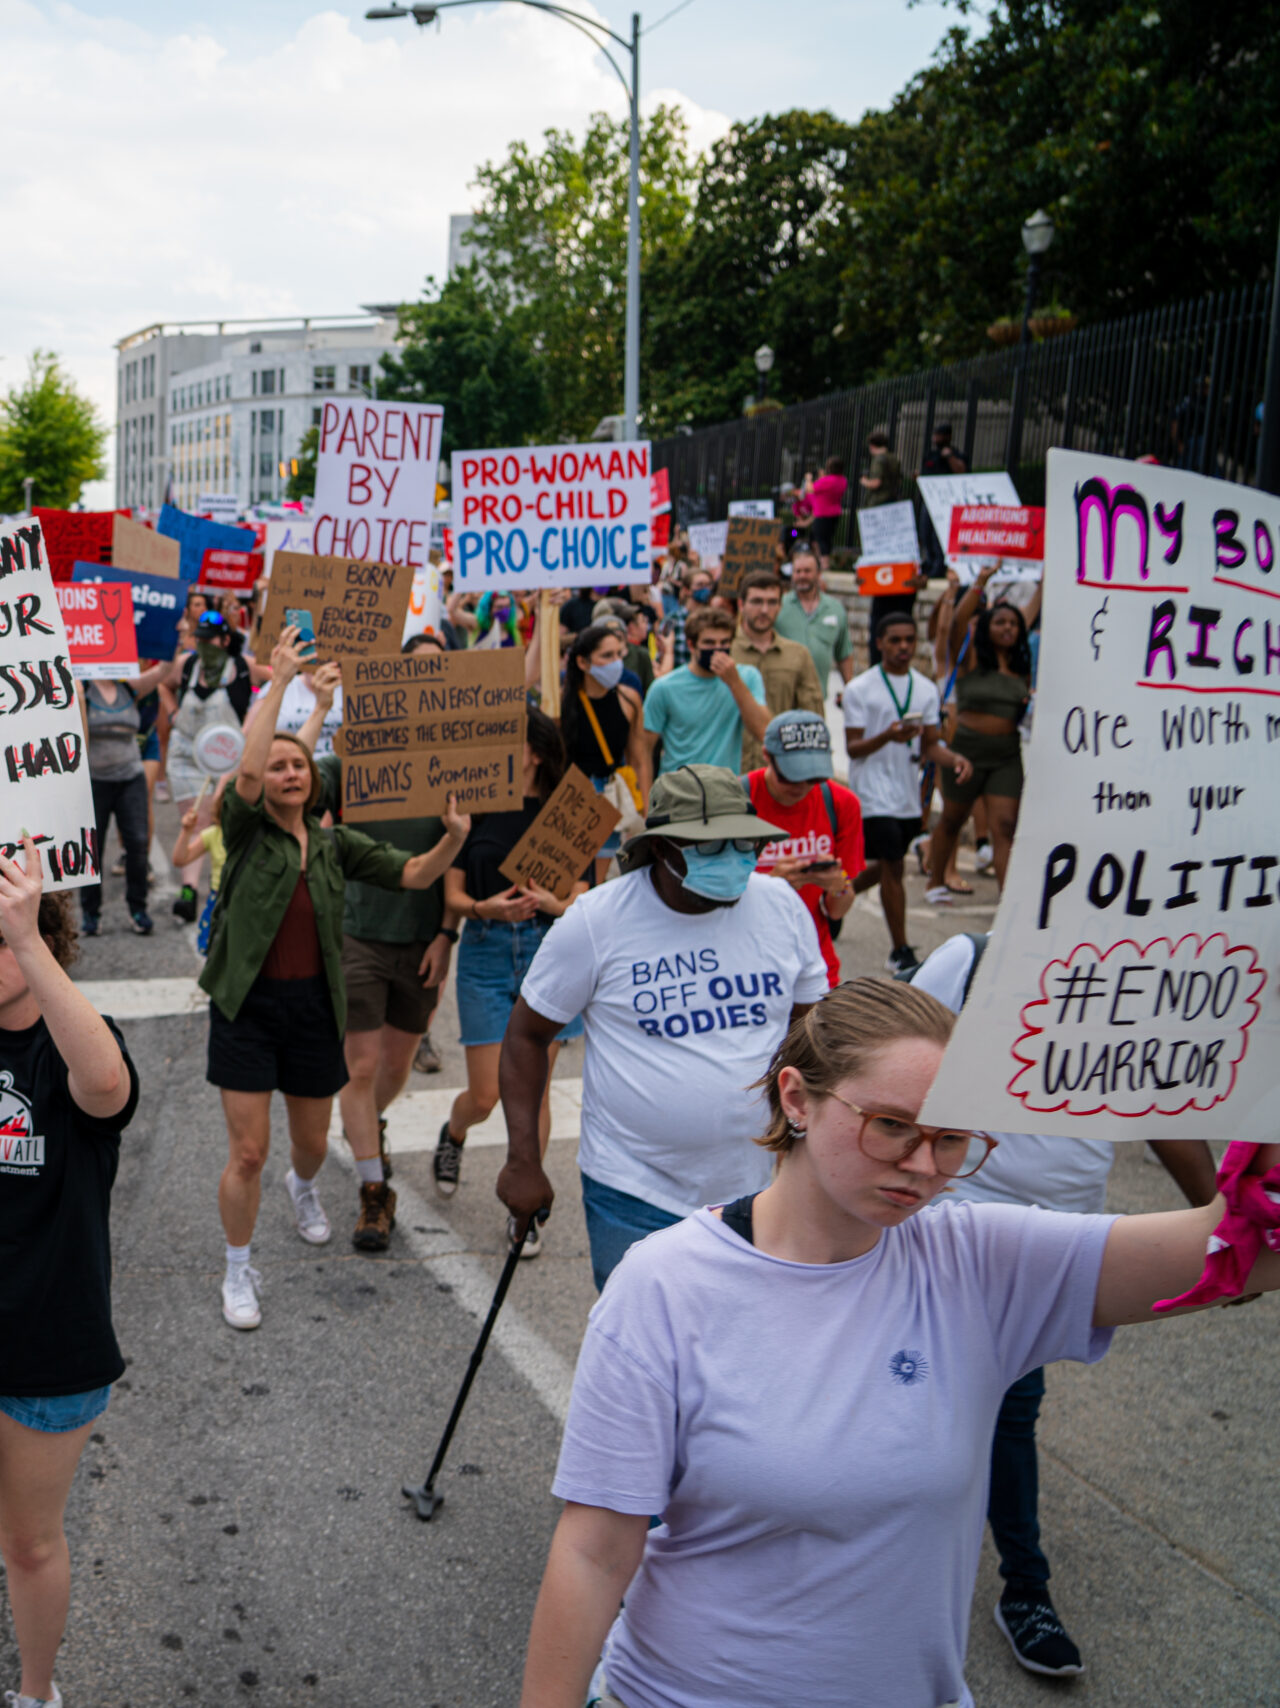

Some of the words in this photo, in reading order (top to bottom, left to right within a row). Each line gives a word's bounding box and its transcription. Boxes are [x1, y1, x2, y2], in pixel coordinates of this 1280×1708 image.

[321, 403, 443, 461] PARENT
[349, 463, 399, 507] BY
[462, 447, 647, 489] PRO-WOMAN
[463, 489, 627, 525] PRO-CHILD
[960, 507, 1029, 525] ABORTIONS
[314, 515, 427, 567] CHOICE
[458, 524, 649, 578] PRO-CHOICE
[958, 528, 1028, 548] HEALTHCARE
[346, 564, 397, 588] BORN
[304, 586, 326, 600] not
[343, 588, 379, 607] FED
[322, 606, 393, 629] EDUCATED
[355, 656, 449, 681] ABORTION:
[346, 689, 408, 722] NEVER
[418, 688, 446, 714] AN
[450, 684, 482, 709] EASY
[483, 685, 526, 707] CHOICE
[345, 725, 410, 752] SOMETIMES
[415, 724, 438, 742] THE
[441, 719, 476, 742] BEST
[476, 719, 518, 737] CHOICE
[1064, 706, 1132, 757] are
[1162, 702, 1249, 752] worth
[5, 732, 82, 783] HAD
[427, 762, 500, 788] WOMAN'S
[346, 760, 413, 801] ALWAYS
[446, 782, 497, 804] CHOICE
[581, 805, 601, 831] TO
[1094, 780, 1152, 814] than
[1189, 785, 1246, 836] your
[760, 830, 832, 859] ernie
[1038, 843, 1280, 929] POLITI
[632, 948, 719, 986] BANS
[633, 981, 697, 1014] OFF
[708, 972, 784, 1001] OUR
[1054, 963, 1239, 1025] #ENDO
[638, 1002, 767, 1038] BODIES
[1043, 1038, 1226, 1095] WARRIOR
